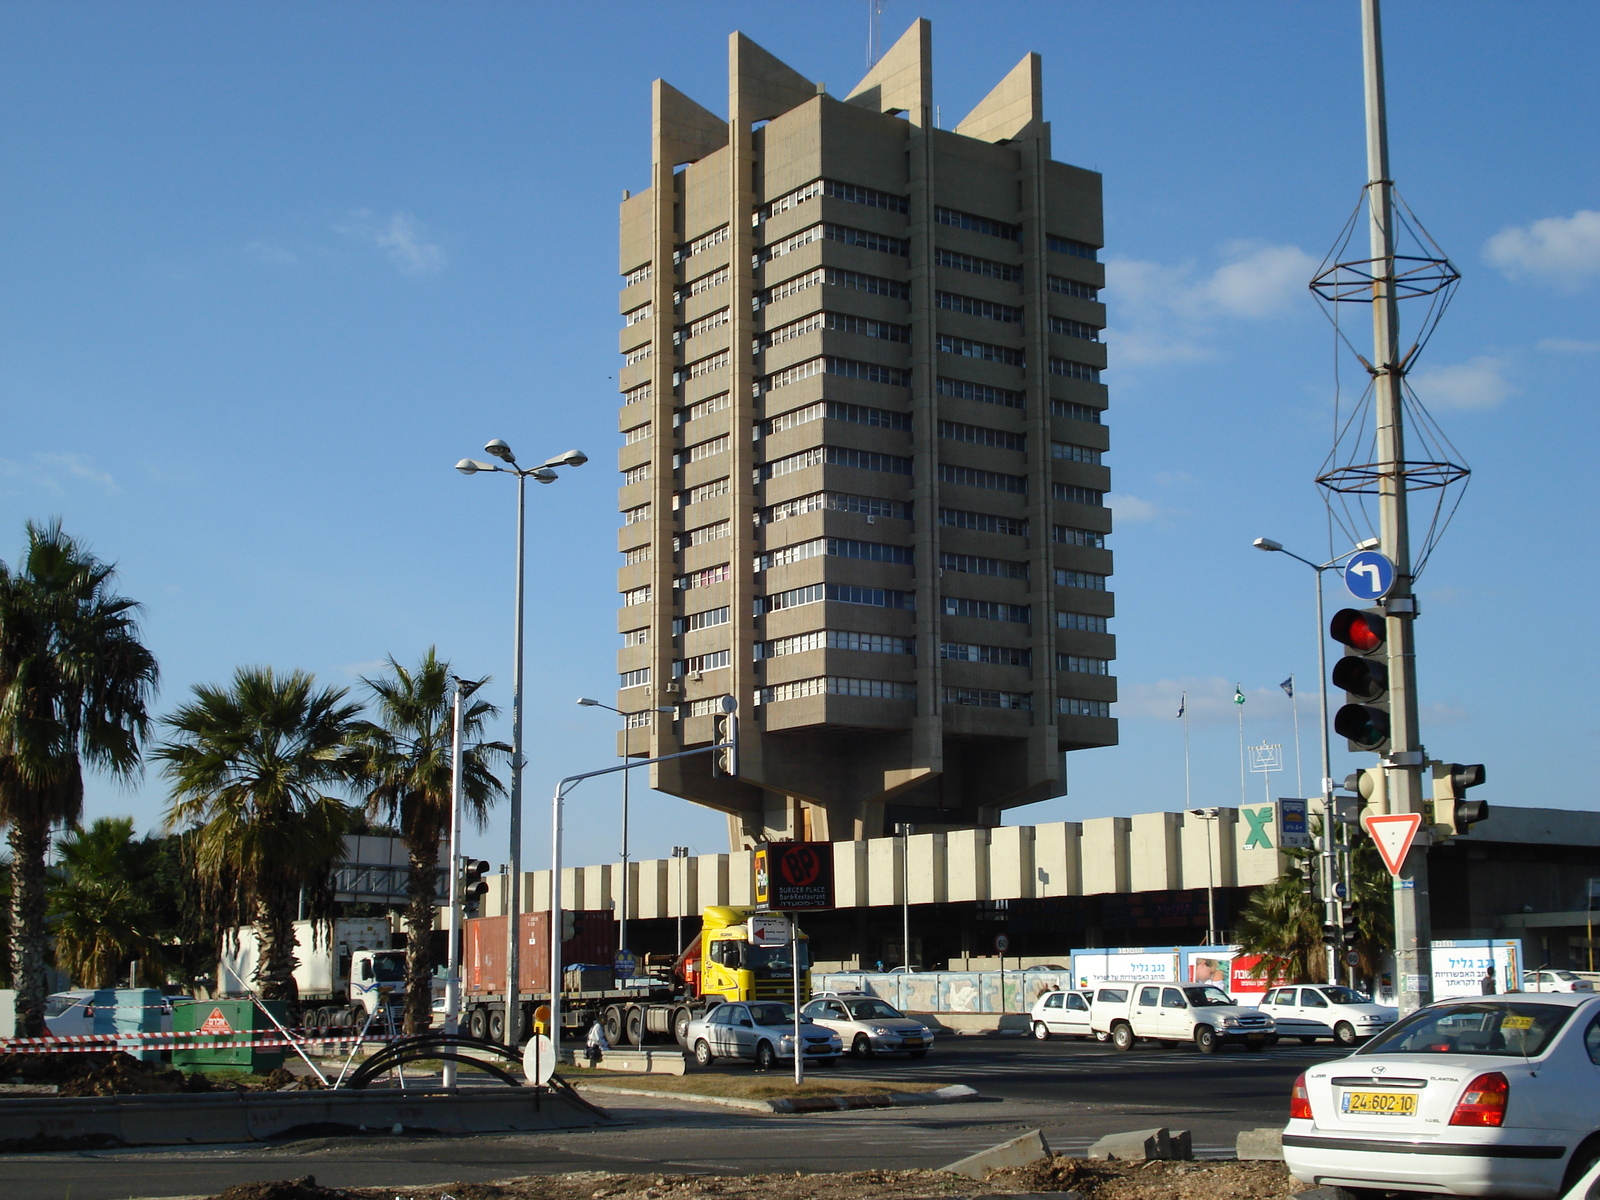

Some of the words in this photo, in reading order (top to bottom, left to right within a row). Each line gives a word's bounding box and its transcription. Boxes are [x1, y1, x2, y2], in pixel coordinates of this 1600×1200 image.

[785, 848, 814, 883] BP
[1131, 963, 1149, 972] גליל
[1151, 964, 1165, 972] נגב
[1449, 958, 1474, 969] גליל
[1446, 979, 1475, 987] לקראתך
